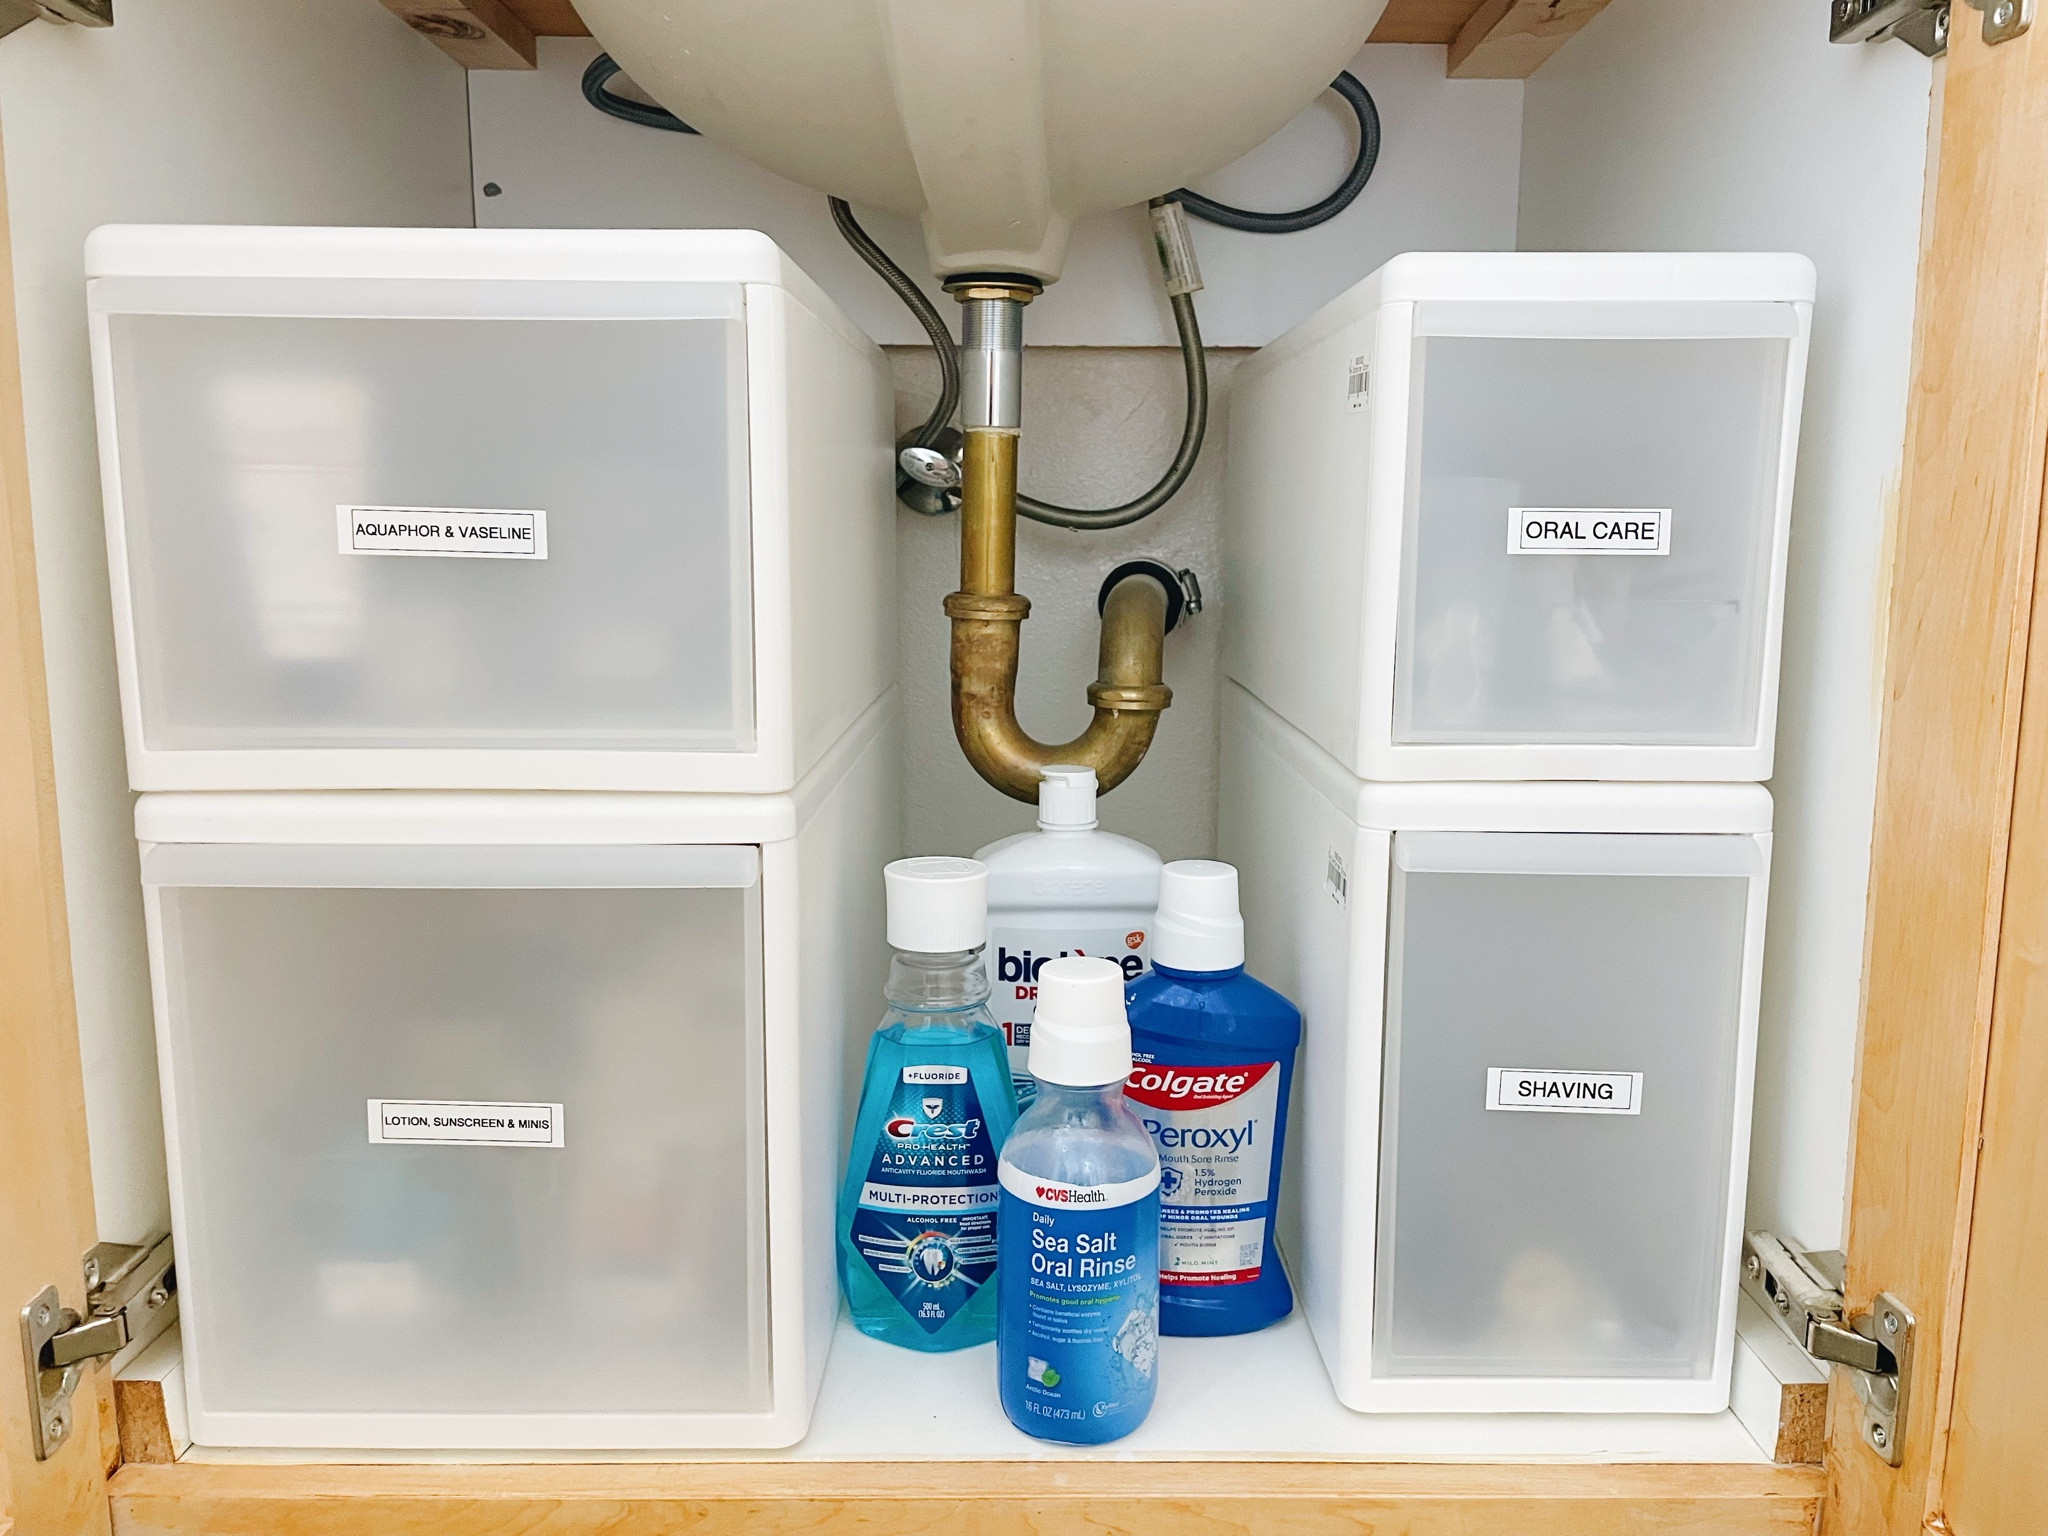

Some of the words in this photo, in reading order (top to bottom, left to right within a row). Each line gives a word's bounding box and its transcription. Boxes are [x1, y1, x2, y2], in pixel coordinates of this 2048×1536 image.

[355, 523, 440, 538] AQUAPHOR
[444, 526, 454, 538] &
[458, 526, 531, 540] VASELINE
[1525, 521, 1586, 539] ORAL
[1592, 521, 1655, 540] CARE
[1127, 934, 1142, 946] gsk
[1015, 985, 1038, 1000] DR
[1125, 1067, 1246, 1099] Colgate
[1517, 1080, 1613, 1100] SHAVING
[384, 1116, 431, 1128] LOTION,
[433, 1117, 505, 1128] SUNSCREEN
[507, 1119, 515, 1129] &
[518, 1119, 550, 1130] MINIS
[886, 1118, 981, 1140] Crest
[1143, 1119, 1253, 1154] Peroxyl
[881, 1153, 984, 1167] ADVANCED
[1159, 1154, 1189, 1163] Mouth
[1191, 1154, 1212, 1163] Sore
[1214, 1154, 1239, 1163] Rinse
[881, 1167, 916, 1176] ANTICAVITY
[946, 1168, 987, 1176] MOUTHWASH
[1194, 1168, 1216, 1177] 1.5%
[1194, 1178, 1242, 1187] Hydrogen
[869, 1190, 998, 1206] MULTI-PROTECTION
[1194, 1187, 1237, 1196] Peroxide
[906, 1216, 939, 1224] ALCOHOL
[1032, 1211, 1055, 1227] Daily
[1031, 1228, 1069, 1253] Sea
[1075, 1232, 1117, 1254] Salt
[1031, 1252, 1072, 1278] Oral
[1080, 1254, 1136, 1278] Rinse
[1030, 1277, 1045, 1288] SEA
[1046, 1281, 1066, 1293] SALT,
[1067, 1282, 1111, 1293] LYSOZYME,
[1159, 1273, 1179, 1282] Helps
[1210, 1273, 1237, 1282] Healing
[1029, 1289, 1060, 1304] Promotes
[1025, 1400, 1033, 1412] 16
[1033, 1402, 1041, 1415] FL
[1042, 1405, 1052, 1418] OZ
[1053, 1408, 1070, 1420] (473
[1070, 1409, 1086, 1421] mL)
